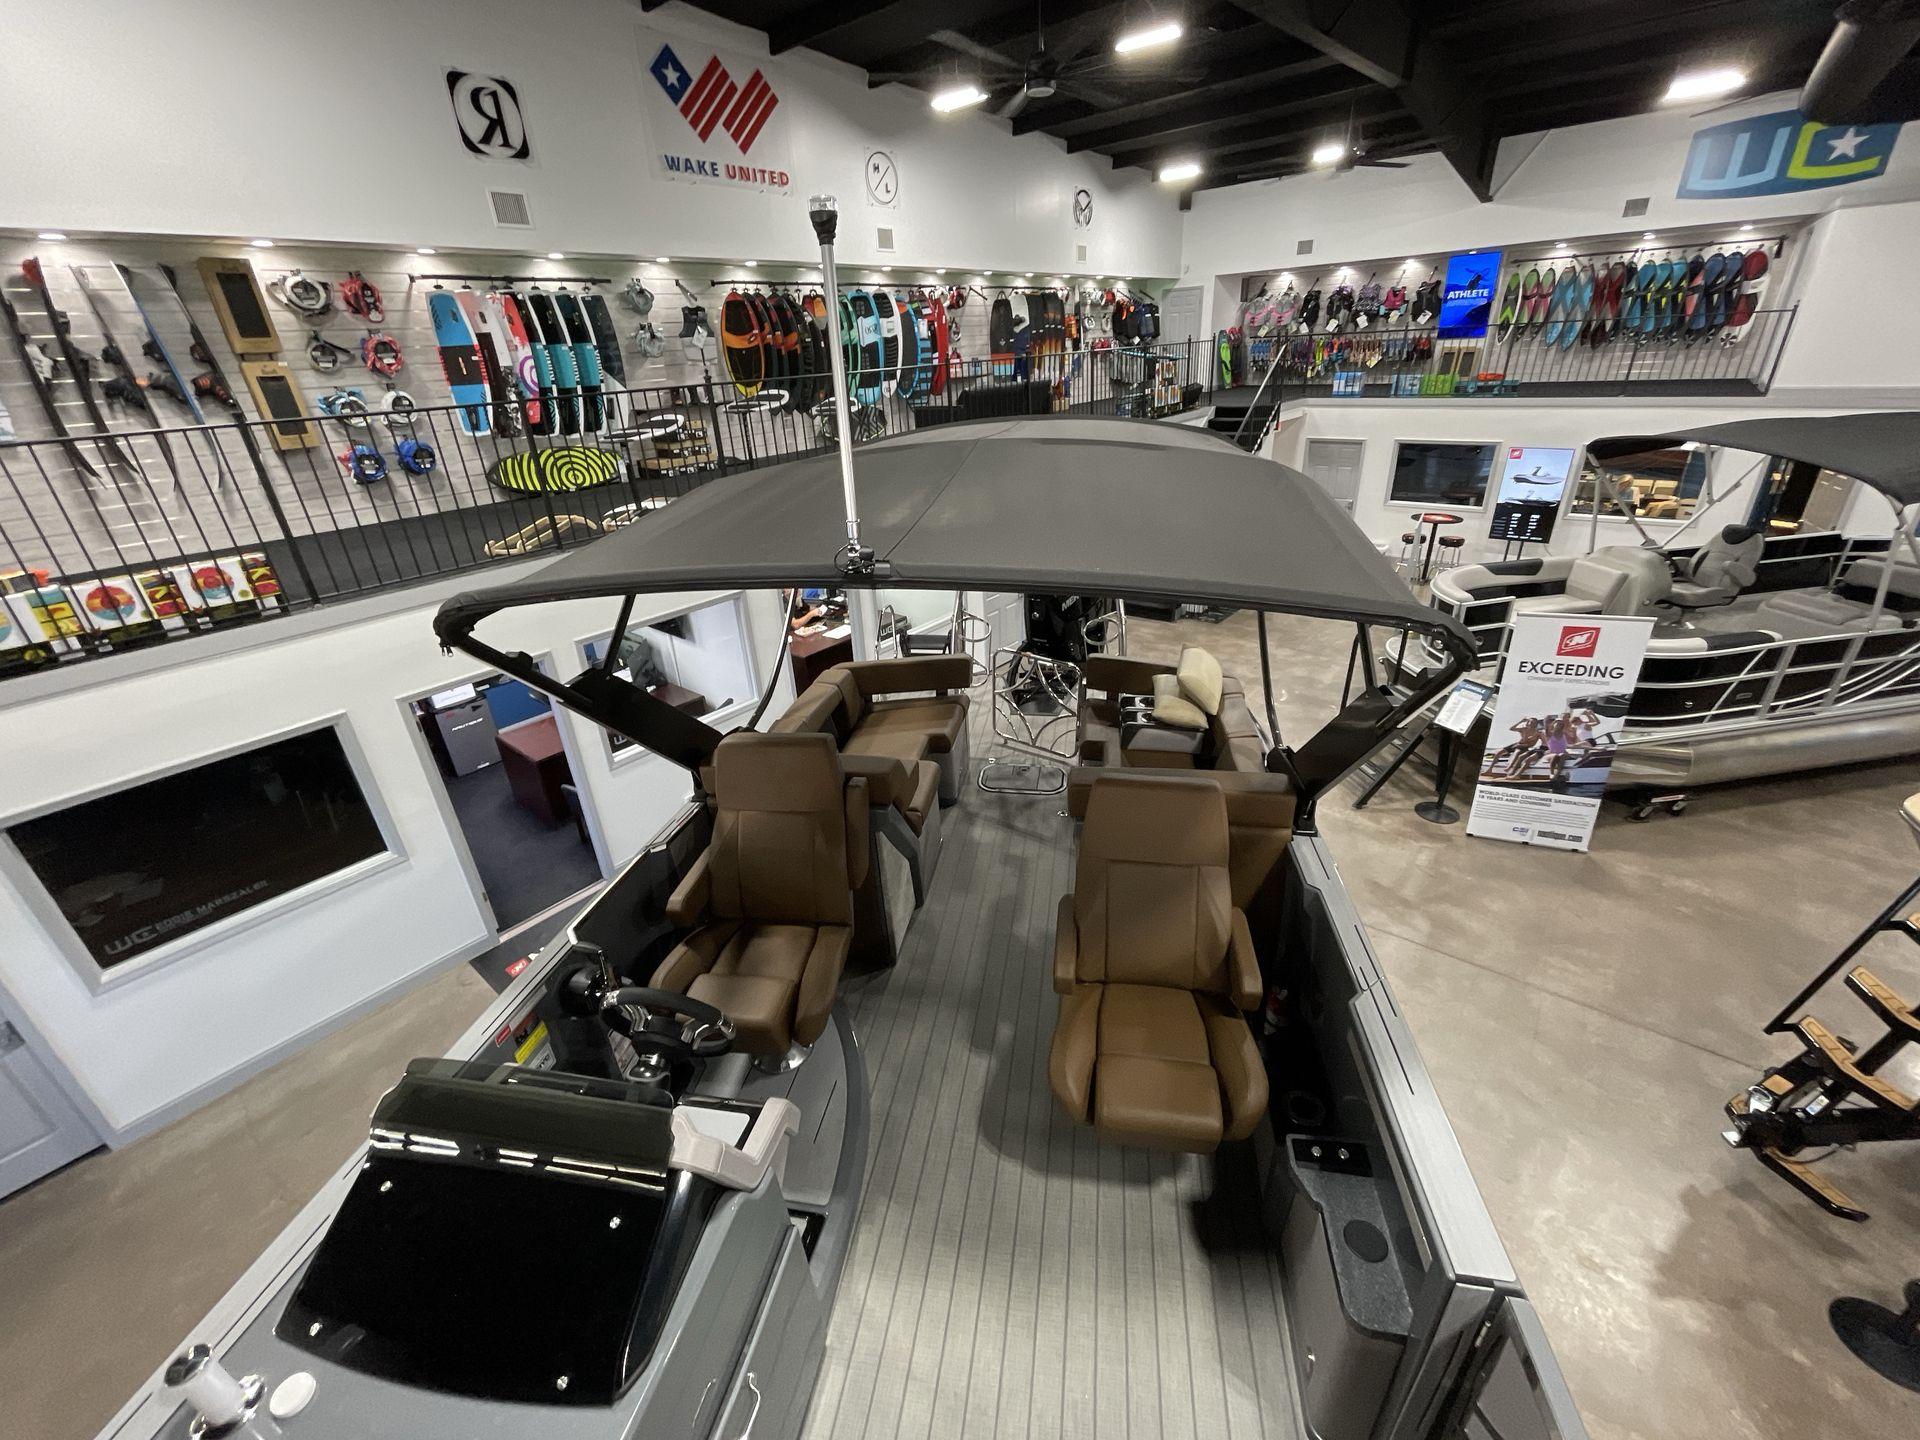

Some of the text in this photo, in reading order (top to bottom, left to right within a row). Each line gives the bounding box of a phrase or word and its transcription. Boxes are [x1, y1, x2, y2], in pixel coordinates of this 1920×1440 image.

[664, 154, 790, 187] WAKE UNITED
[1447, 289, 1489, 299] ATHLETE
[1518, 661, 1625, 679] EXCEEDING
